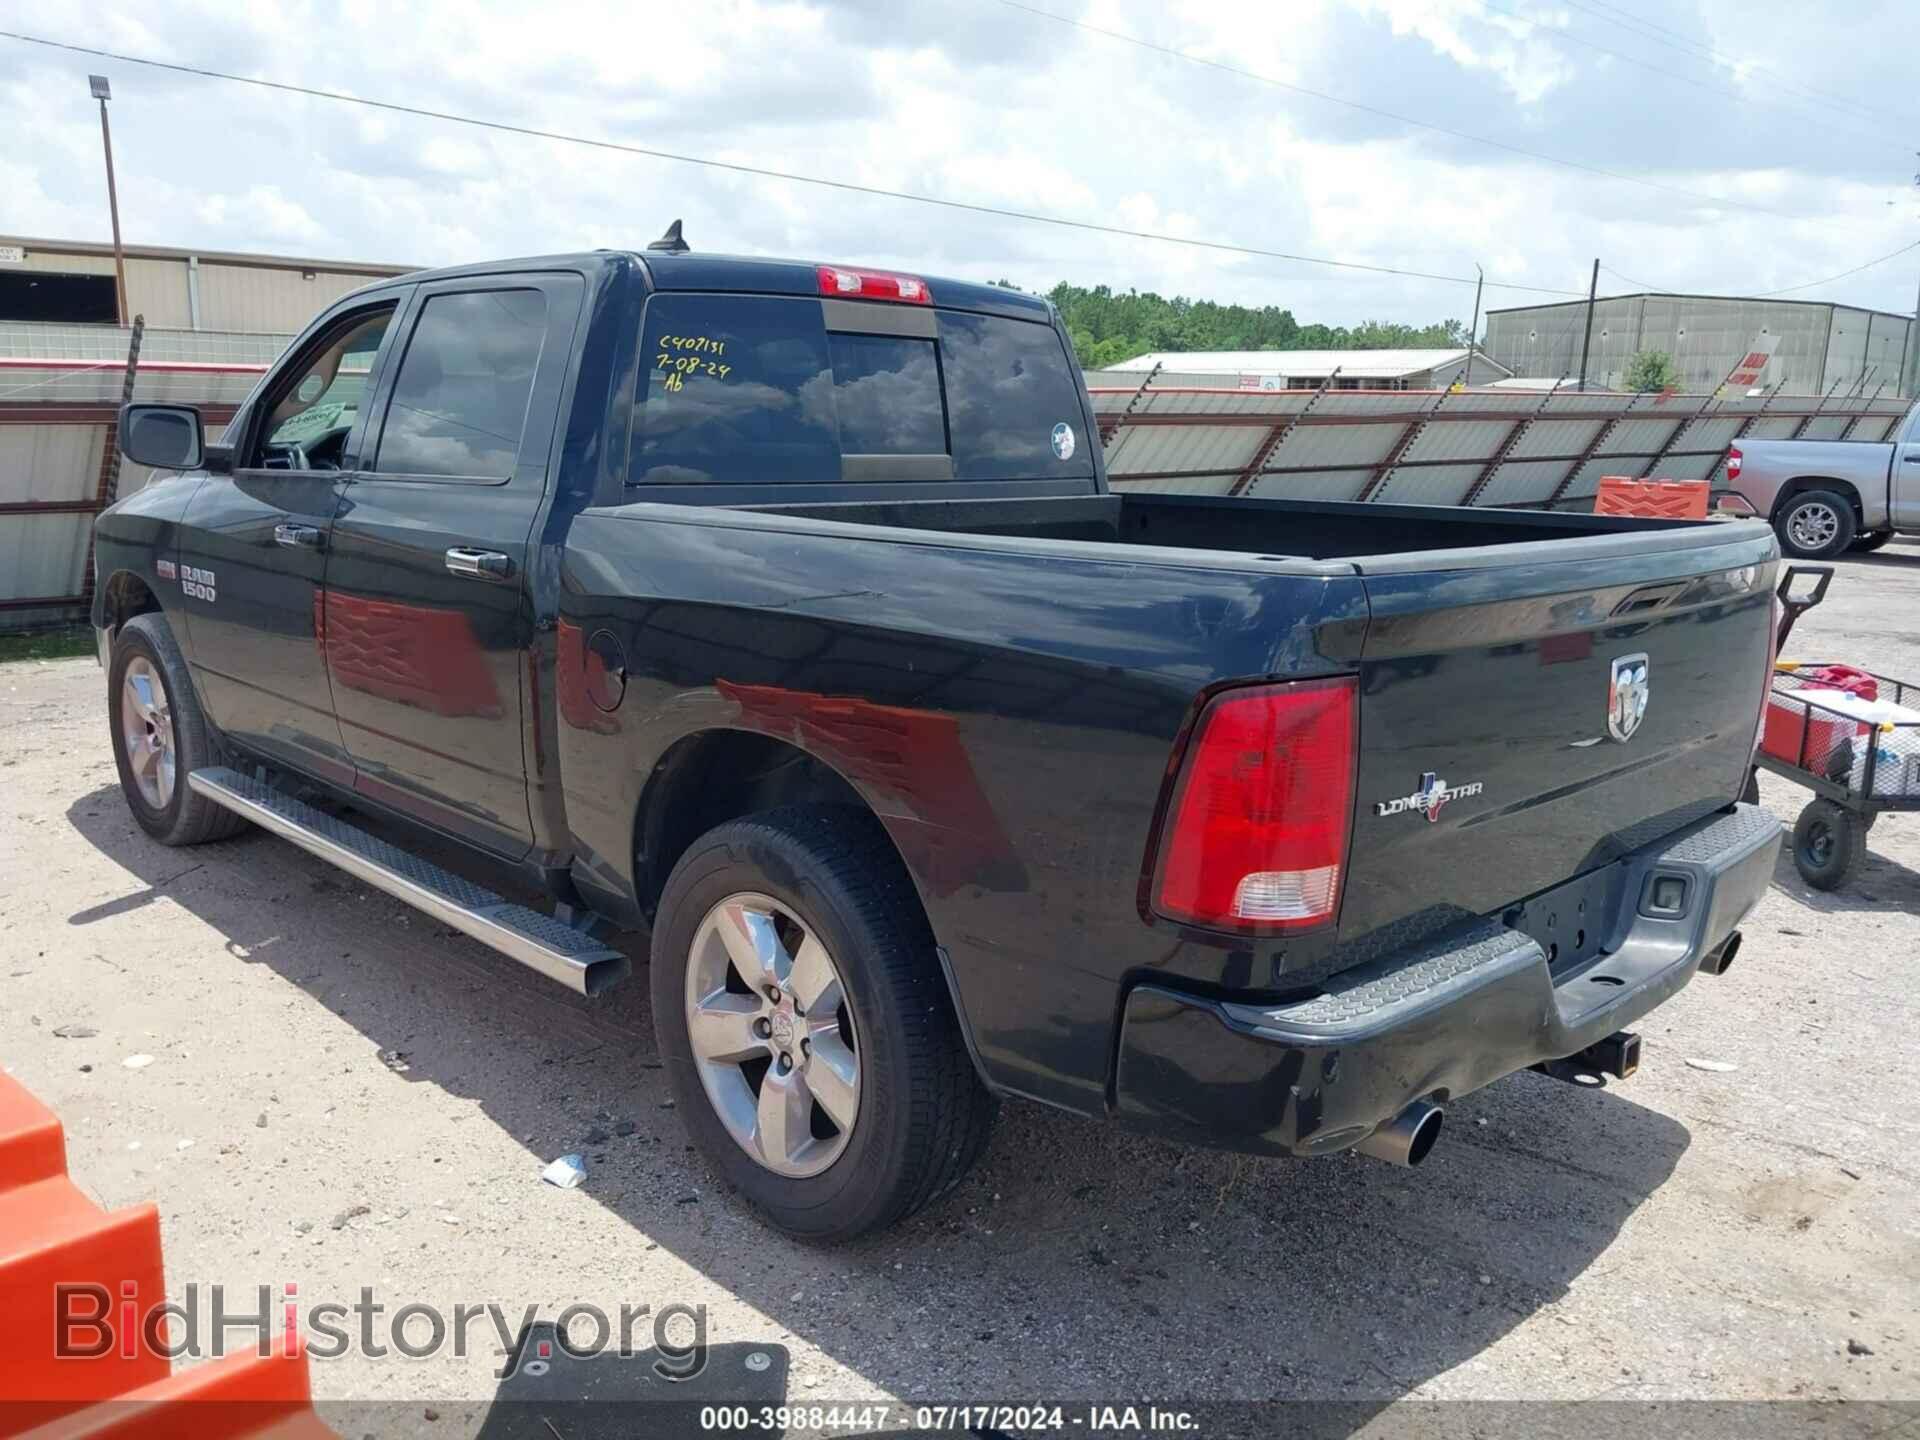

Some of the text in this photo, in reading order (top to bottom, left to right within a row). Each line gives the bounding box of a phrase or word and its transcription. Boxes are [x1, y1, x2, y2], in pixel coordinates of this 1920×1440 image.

[656, 353, 731, 379] 7-08-24
[182, 579, 216, 602] 1500
[1378, 782, 1483, 816] LONE STAR
